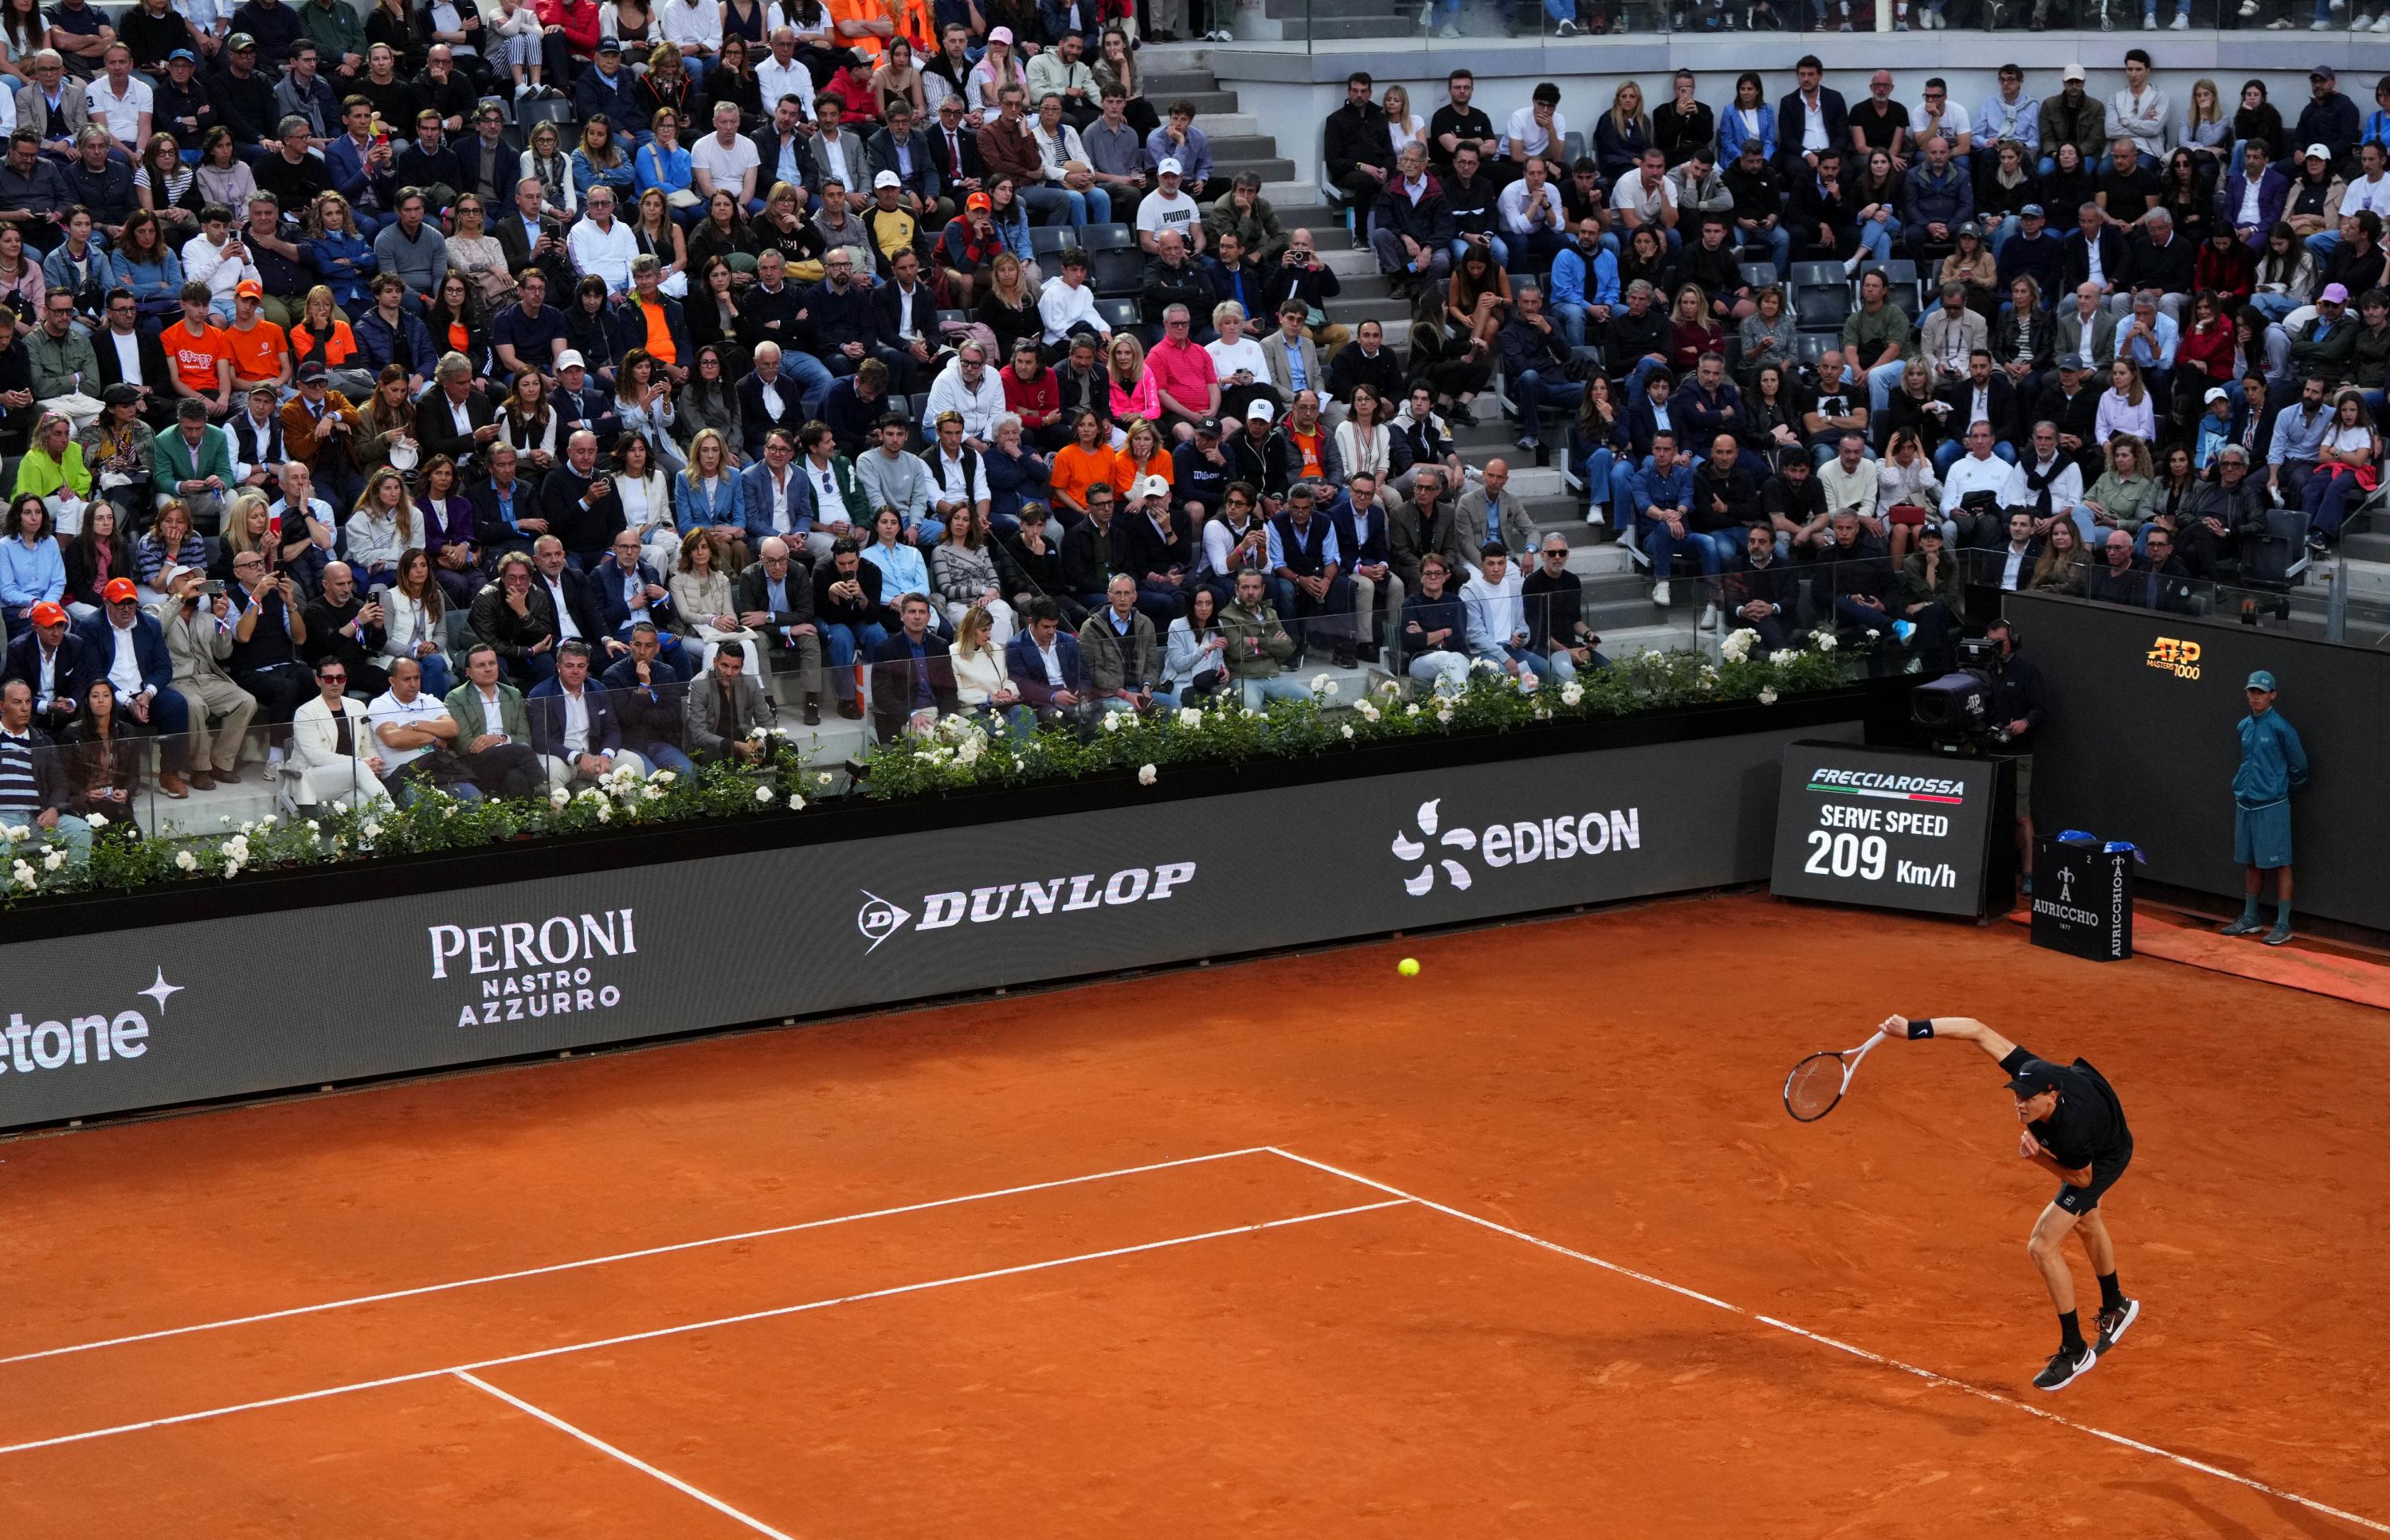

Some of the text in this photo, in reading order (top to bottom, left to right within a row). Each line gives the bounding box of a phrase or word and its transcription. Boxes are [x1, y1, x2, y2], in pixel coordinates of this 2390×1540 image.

[87, 96, 95, 108] 3
[1163, 209, 1190, 223] PUMA
[1193, 470, 1220, 480] Wilson
[2145, 637, 2200, 664] ATP
[2146, 659, 2200, 680] MASTERS 1000
[1812, 768, 1965, 795] FRECCIAROSSA
[1820, 805, 1949, 837] SERVE SPEED
[1483, 807, 1640, 868] eDISON
[1804, 830, 1957, 888] 209 Km/h
[2086, 855, 2091, 864] 2
[915, 861, 1197, 931] DUNLOP
[2033, 899, 2098, 927] AURICCHIO
[2112, 876, 2122, 957] AURICCHIO
[429, 908, 637, 979] PERONI
[482, 967, 591, 997] NASTRO
[458, 986, 621, 1028] AZZURRO
[0, 1010, 150, 1074] tone
